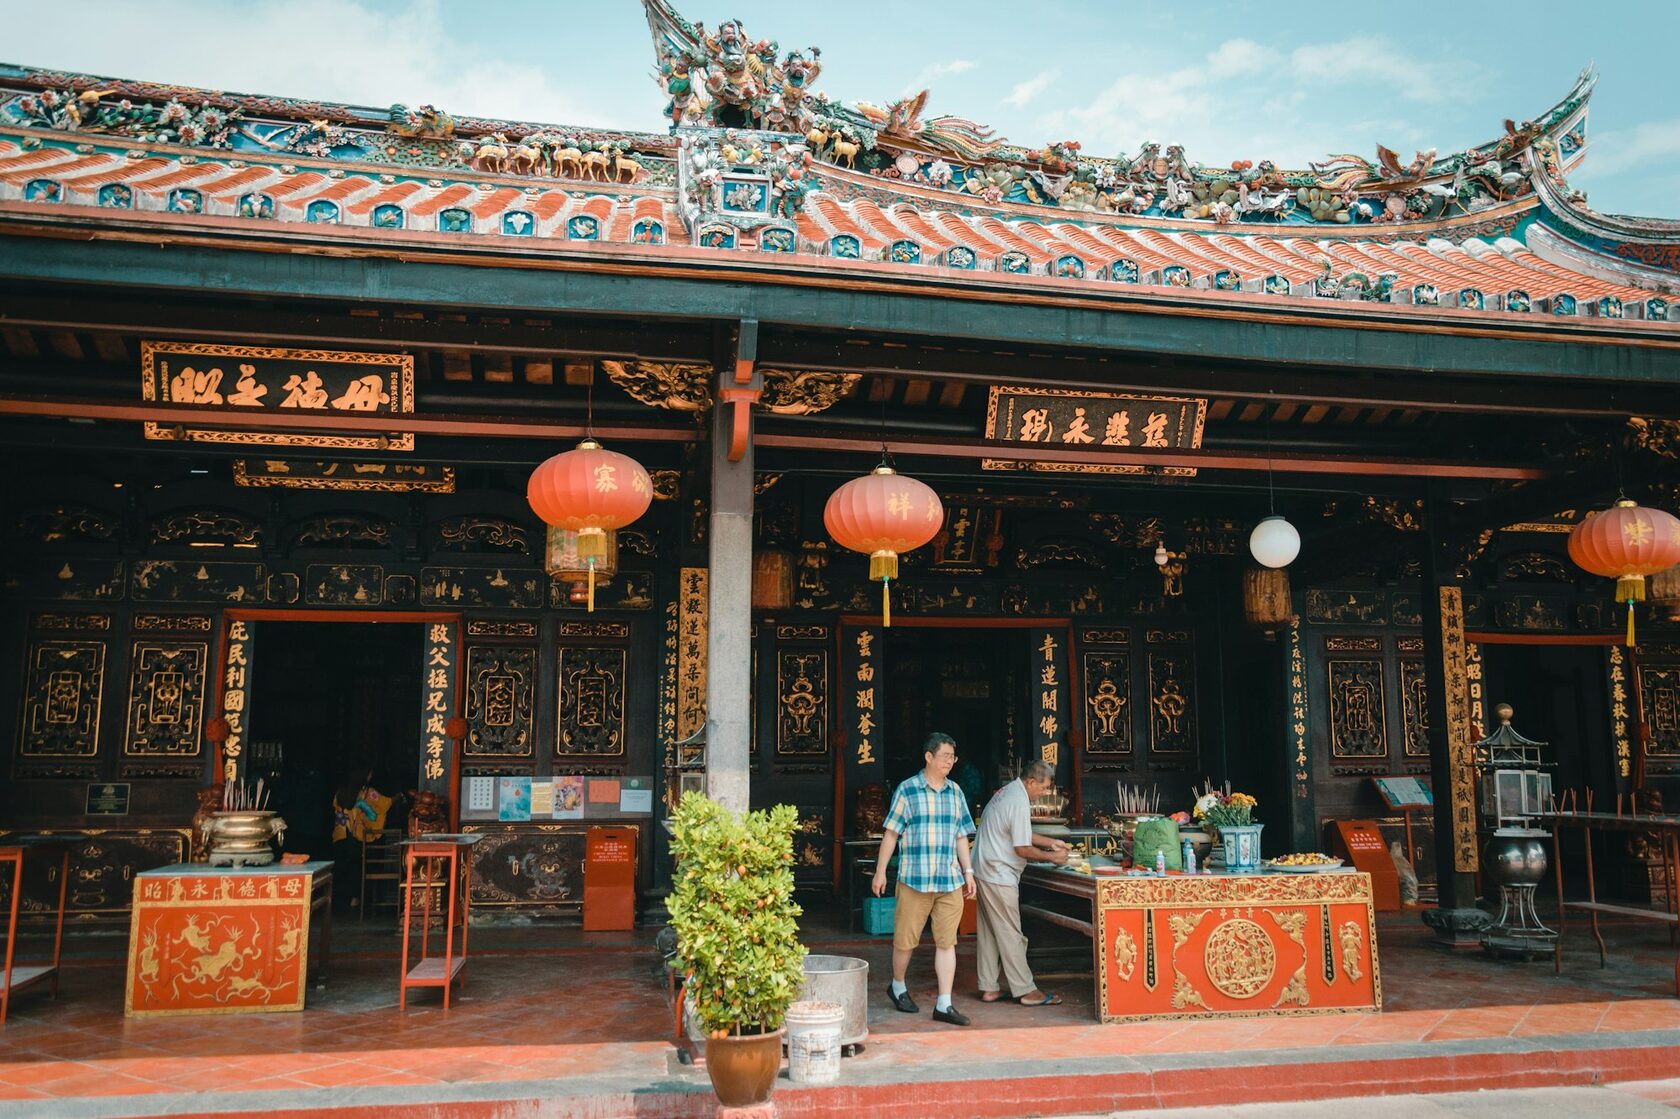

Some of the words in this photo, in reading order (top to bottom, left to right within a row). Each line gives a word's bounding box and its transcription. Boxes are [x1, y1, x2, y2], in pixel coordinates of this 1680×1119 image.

[424, 623, 451, 780] 救父拯兄成孝悌
[1038, 633, 1059, 766] 青蓮開佛國
